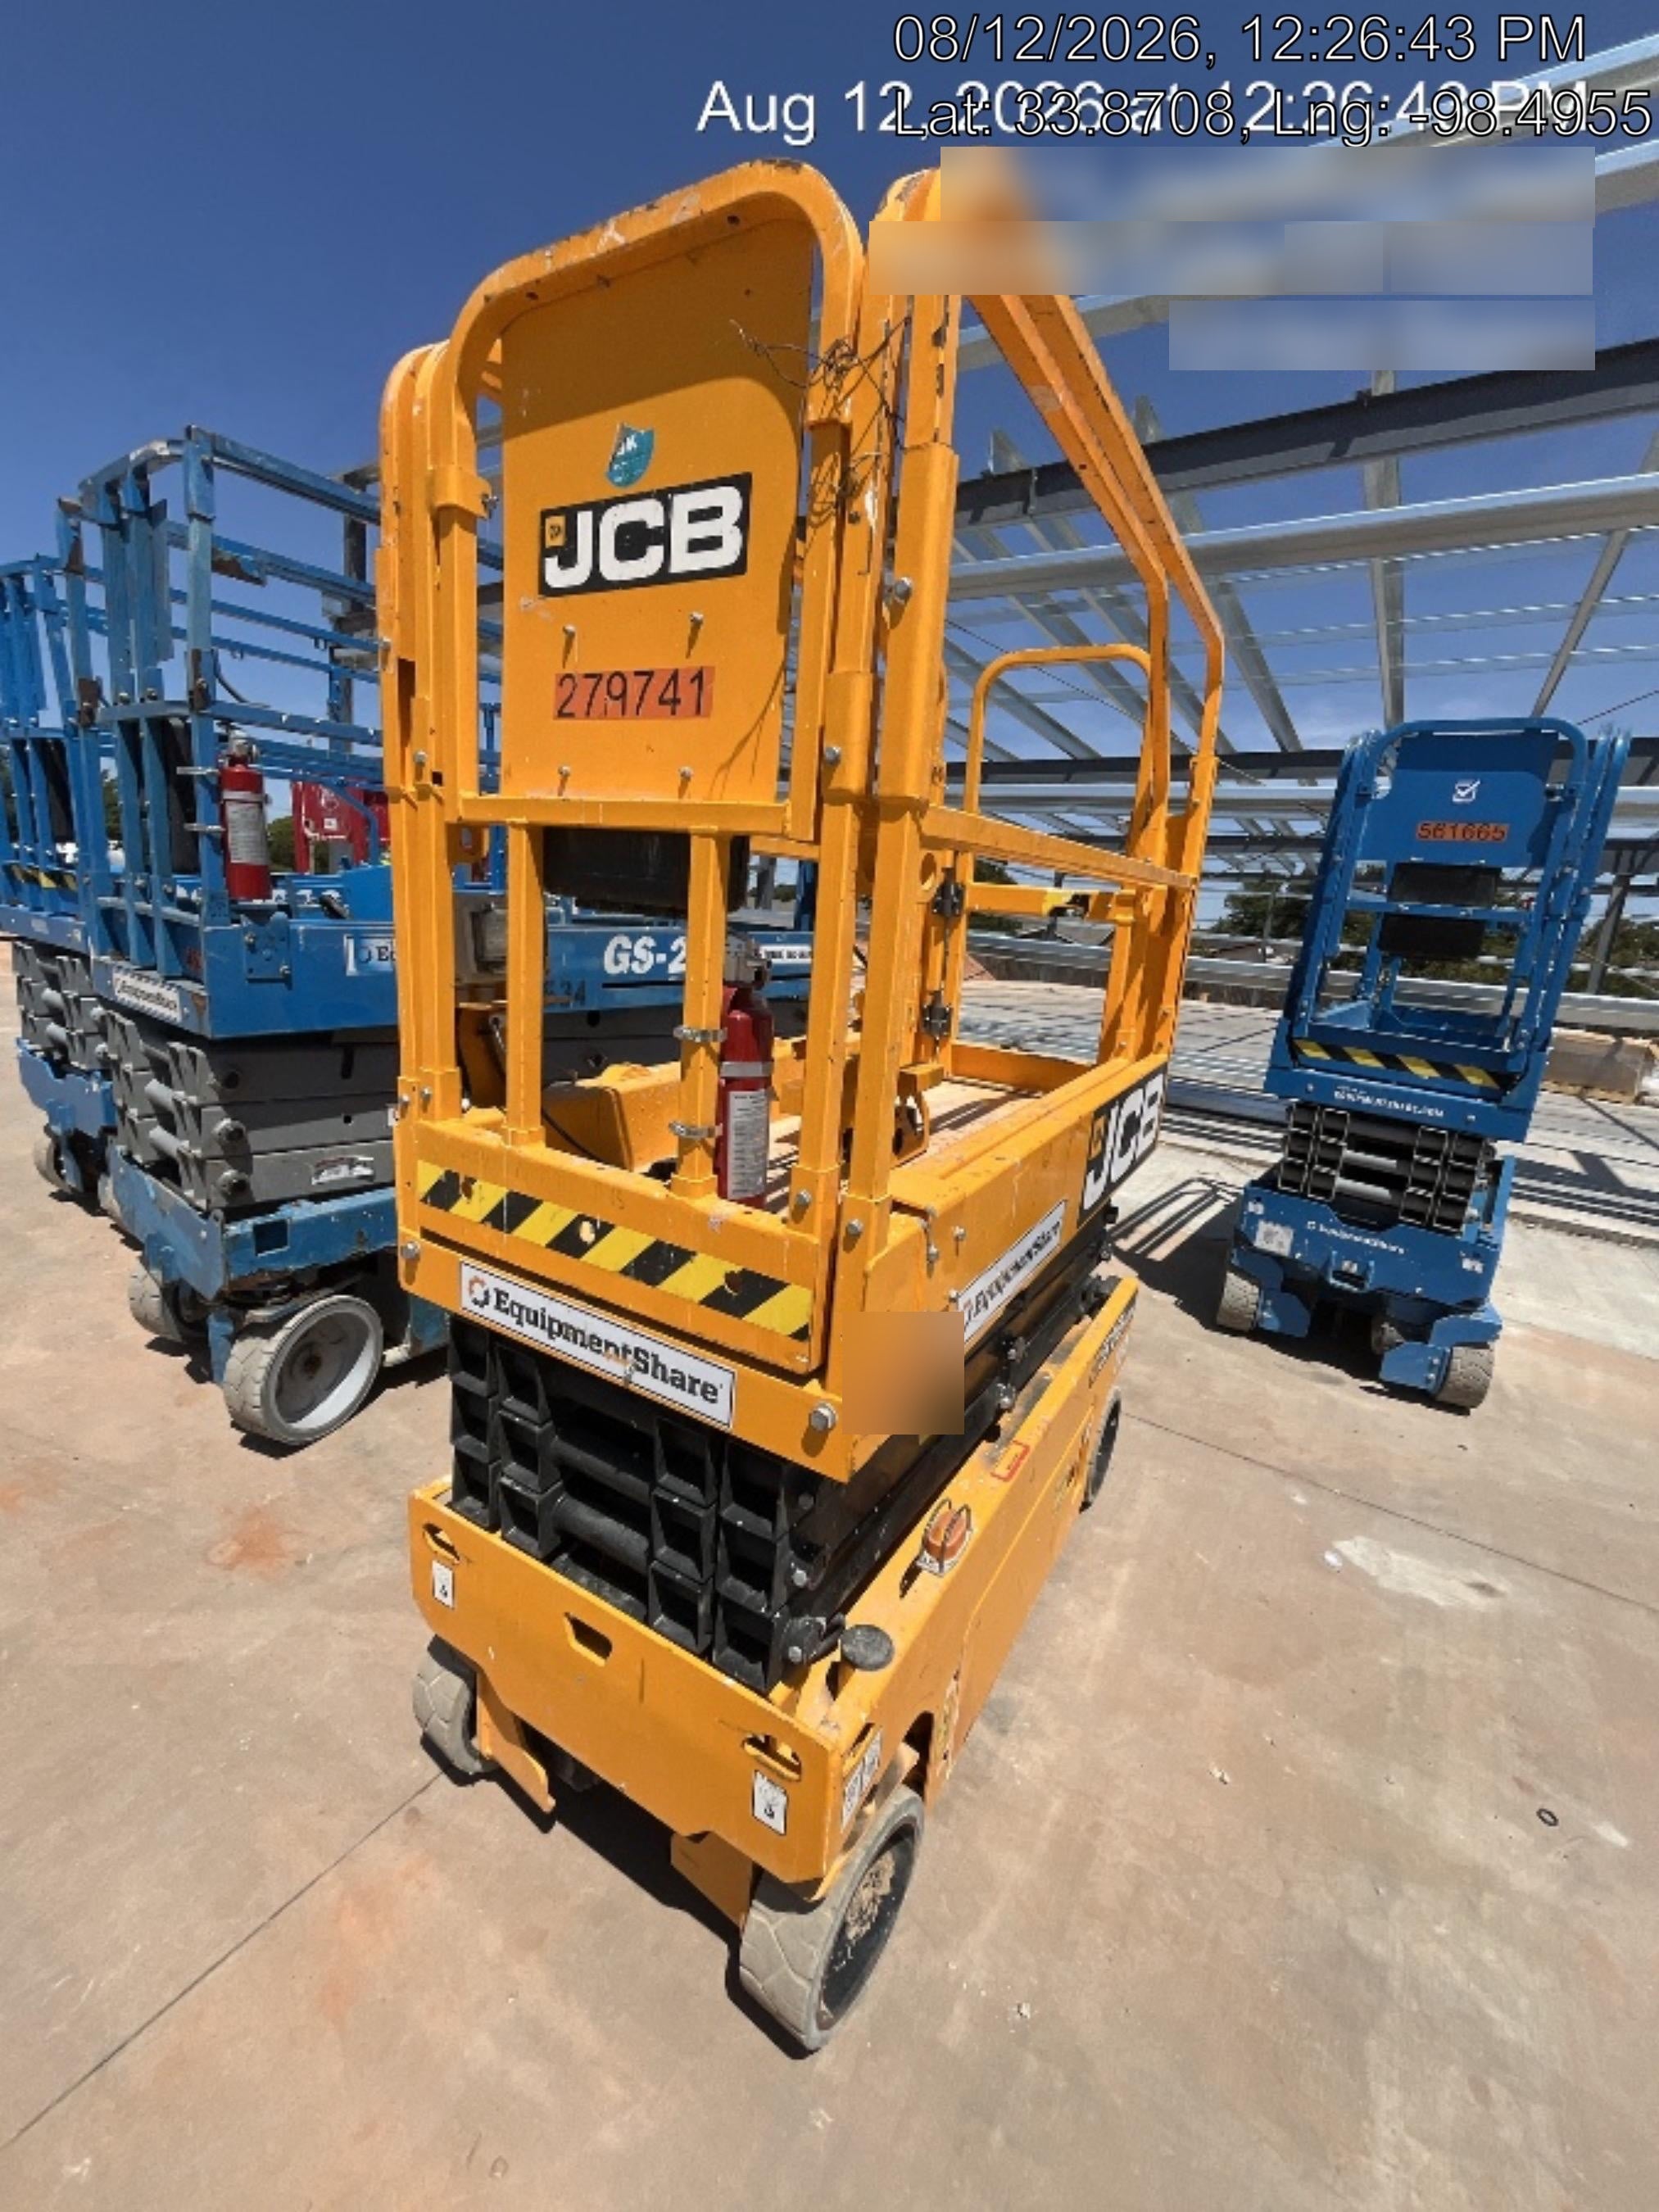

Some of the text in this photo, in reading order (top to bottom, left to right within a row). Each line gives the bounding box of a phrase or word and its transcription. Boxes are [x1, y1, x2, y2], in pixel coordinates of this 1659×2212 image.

[544, 486, 743, 588] JCB
[557, 668, 705, 718] 279741
[1418, 823, 1506, 841] 561665
[604, 934, 687, 975] GS-2
[1084, 1073, 1165, 1210] JCB
[494, 1287, 719, 1404] EquipmentShare
